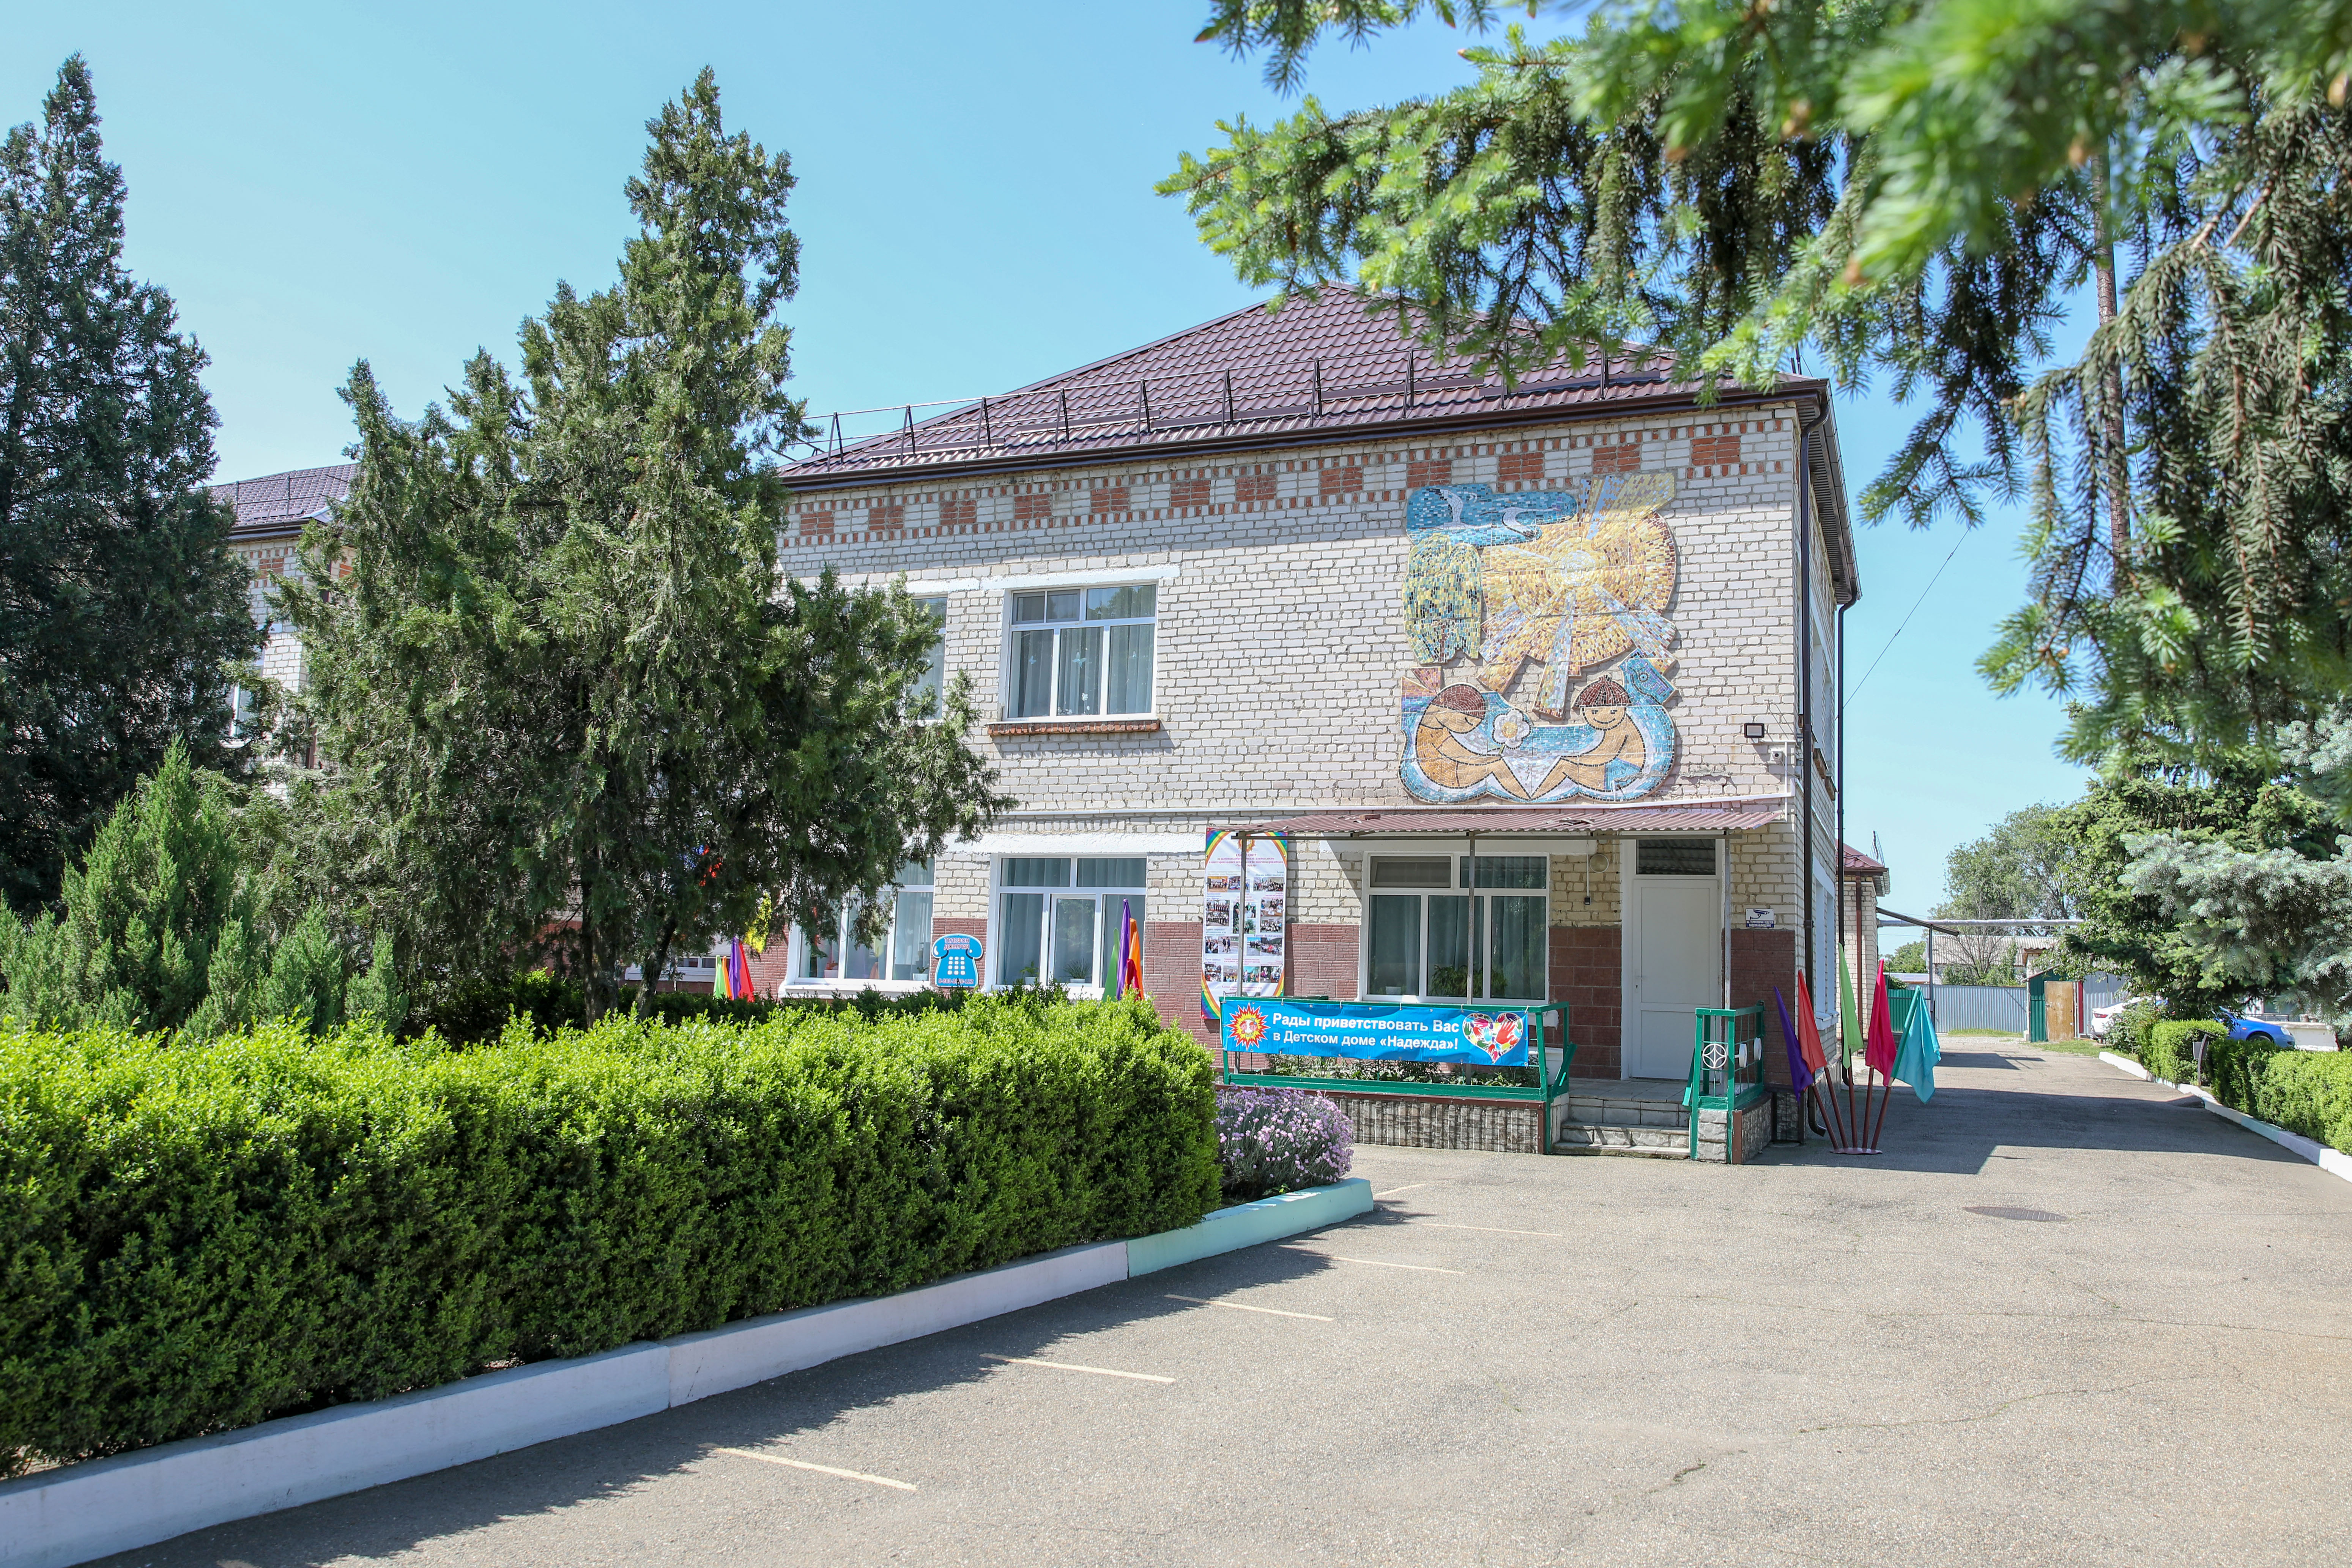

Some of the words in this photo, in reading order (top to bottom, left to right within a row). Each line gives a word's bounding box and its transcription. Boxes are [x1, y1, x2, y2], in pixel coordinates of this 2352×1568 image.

[1273, 1013, 1310, 1027] Рады
[1314, 1017, 1428, 1031] приветствовать
[1433, 1020, 1459, 1032] Вас
[1273, 1032, 1280, 1041] в
[1283, 1030, 1338, 1044] Детском
[1341, 1036, 1375, 1046] доме
[1380, 1035, 1458, 1051] «Надежда»!
